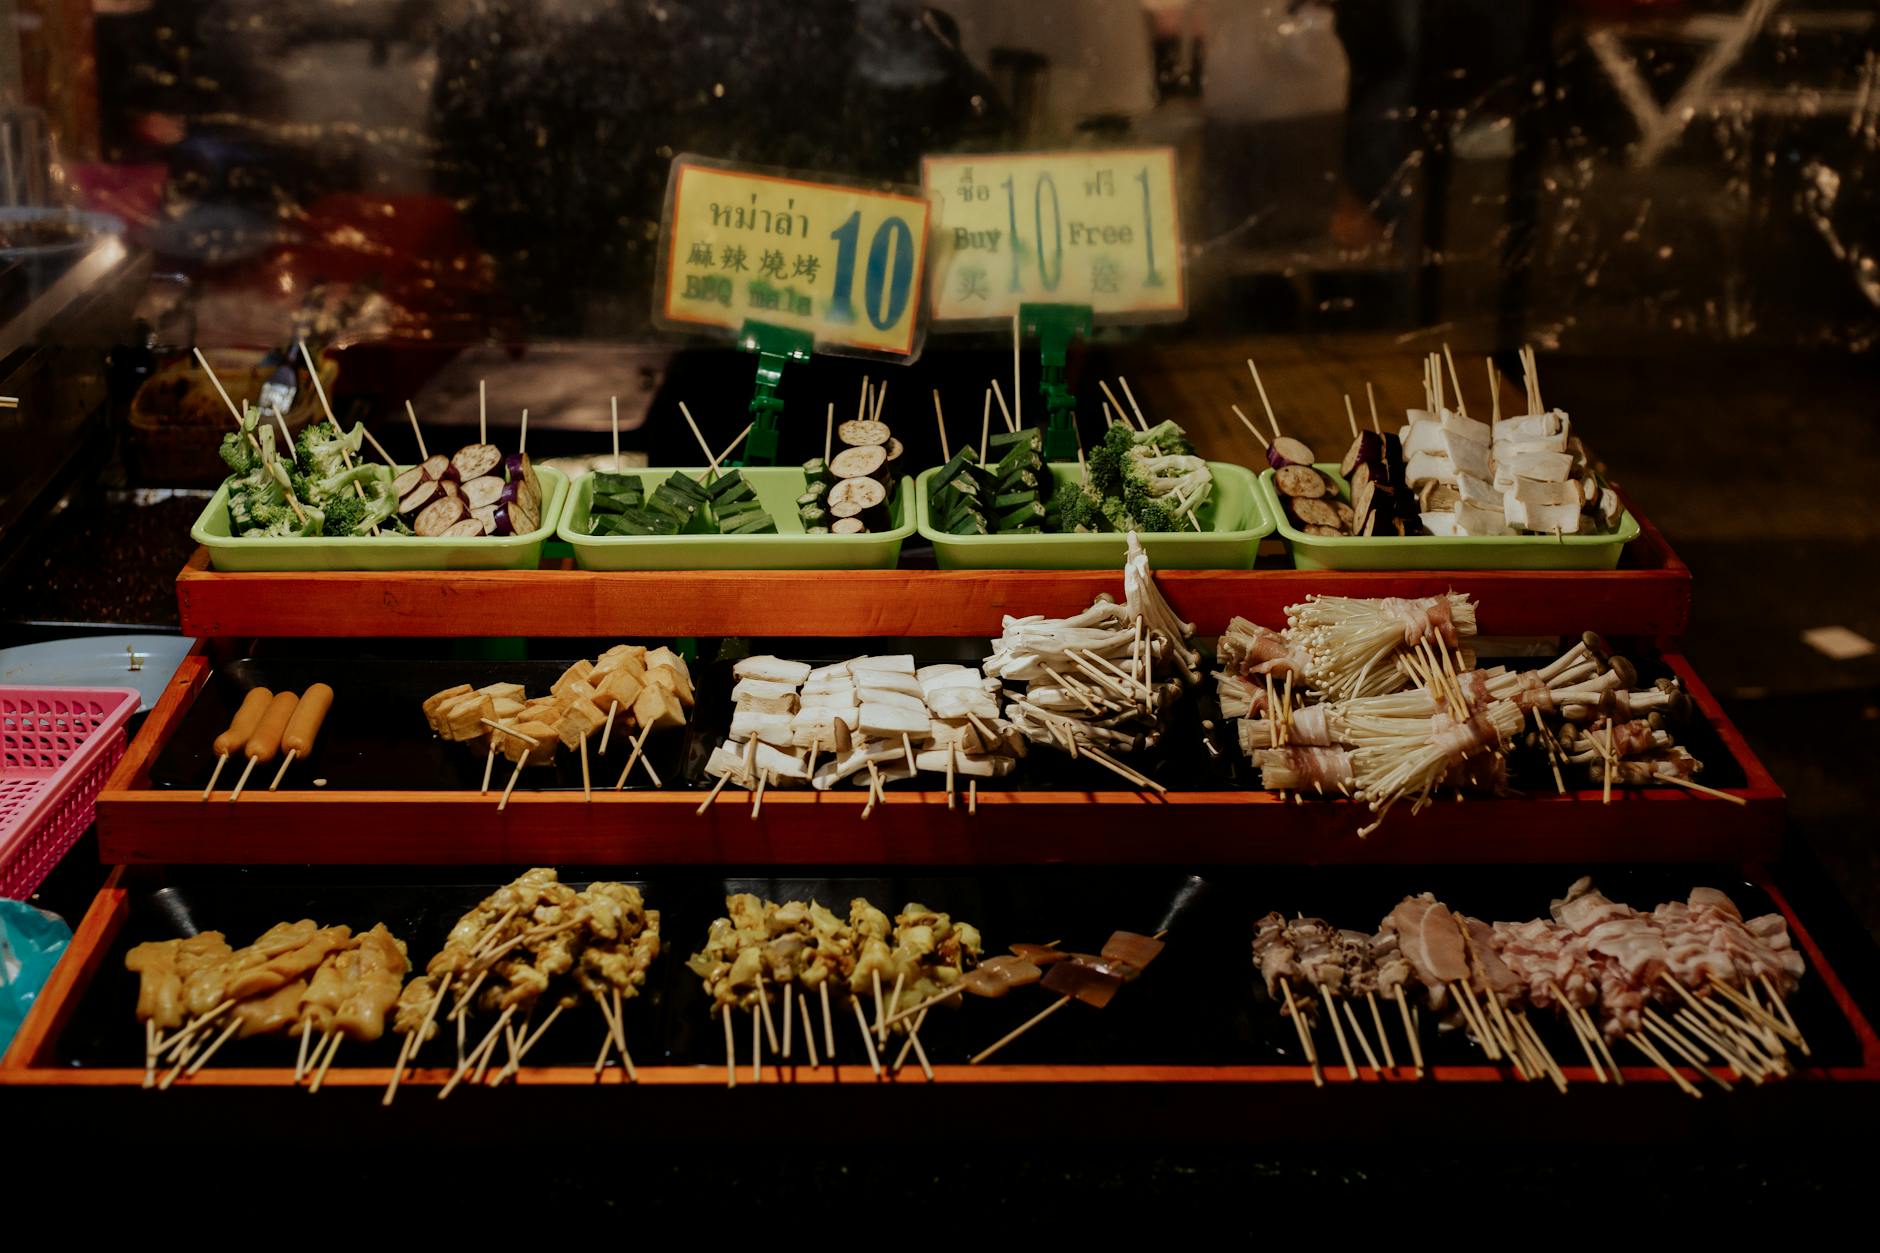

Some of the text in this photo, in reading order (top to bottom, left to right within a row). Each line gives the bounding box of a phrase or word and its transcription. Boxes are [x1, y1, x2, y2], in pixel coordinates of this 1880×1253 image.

[828, 210, 914, 331] 10
[953, 167, 1164, 293] Buy 10 Free 1
